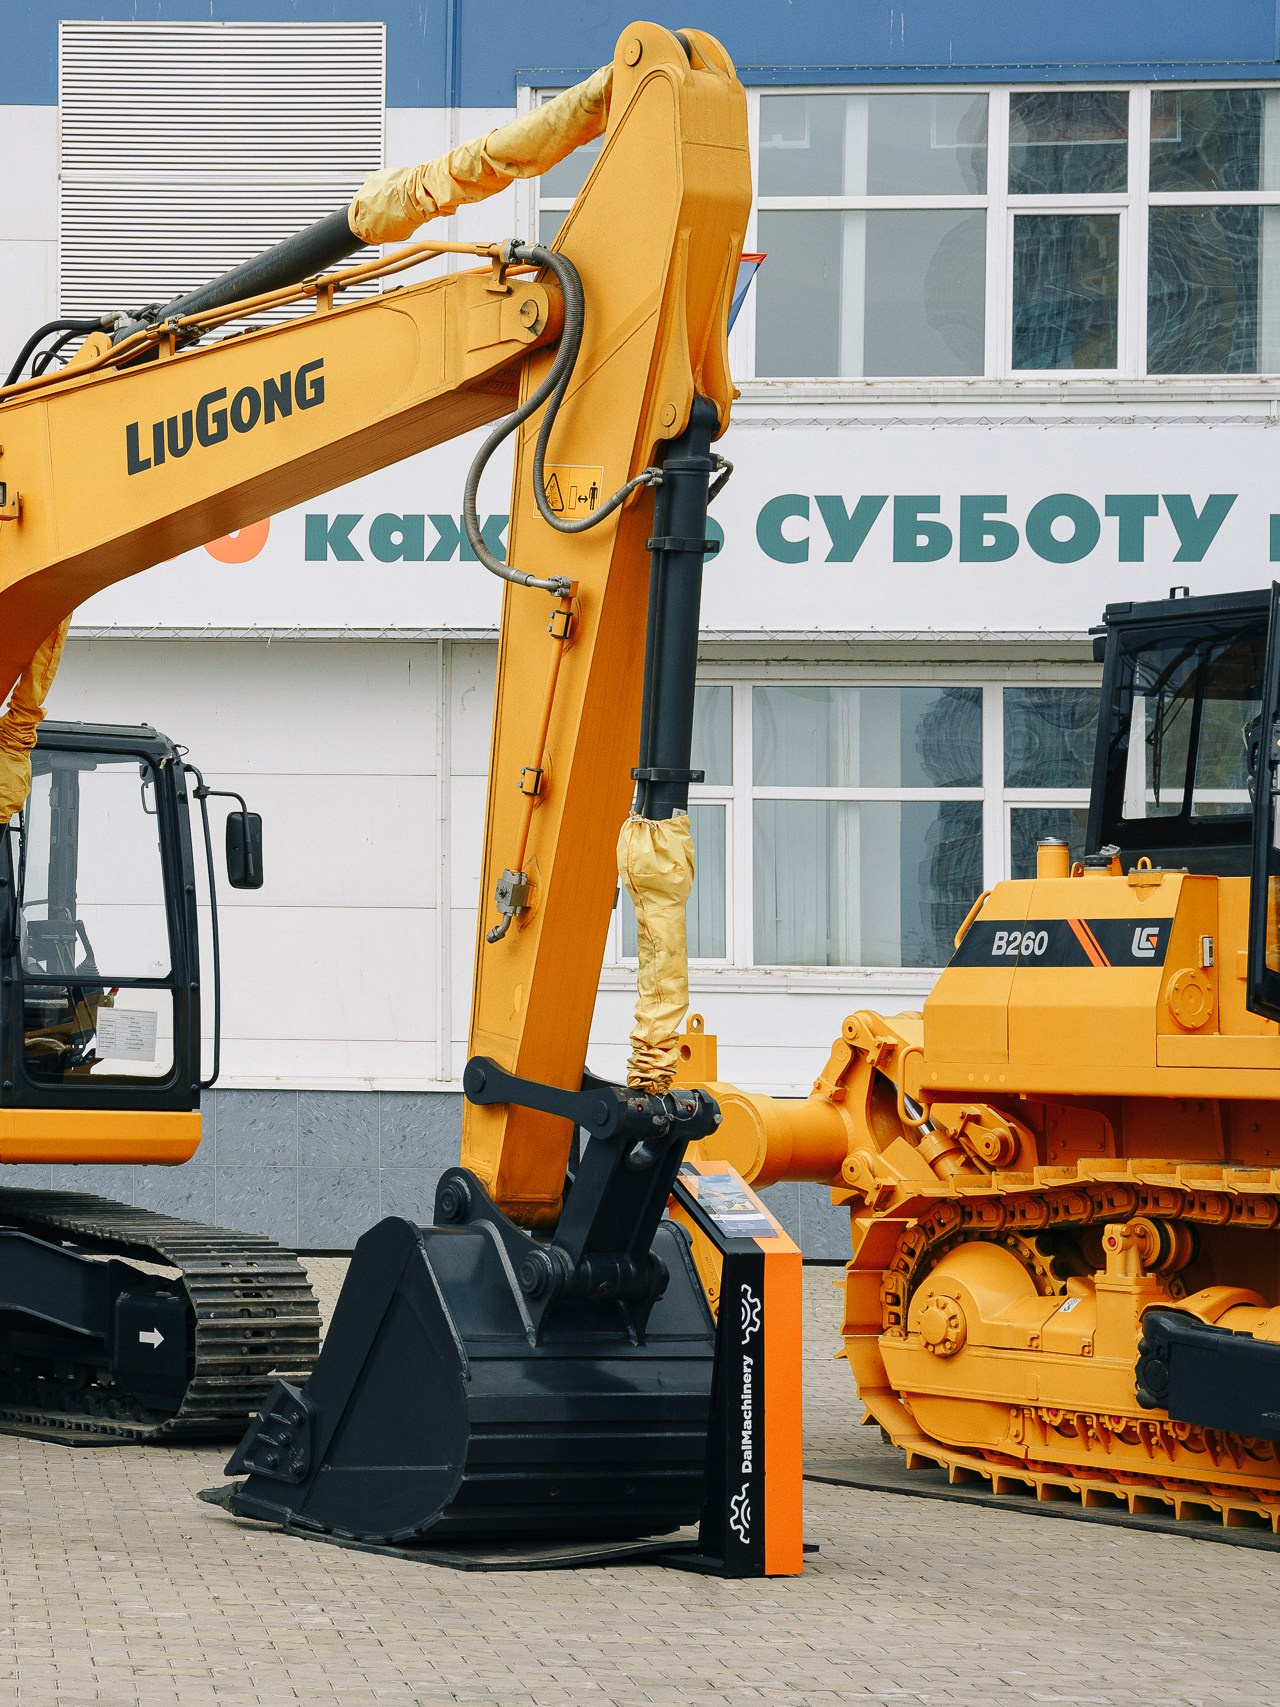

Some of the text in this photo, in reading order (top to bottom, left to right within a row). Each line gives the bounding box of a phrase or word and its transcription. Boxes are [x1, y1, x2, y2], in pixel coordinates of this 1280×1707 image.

[755, 493, 1239, 565] СУББОТУ
[991, 930, 1049, 956] B260
[740, 1354, 754, 1474] DalMachinery
